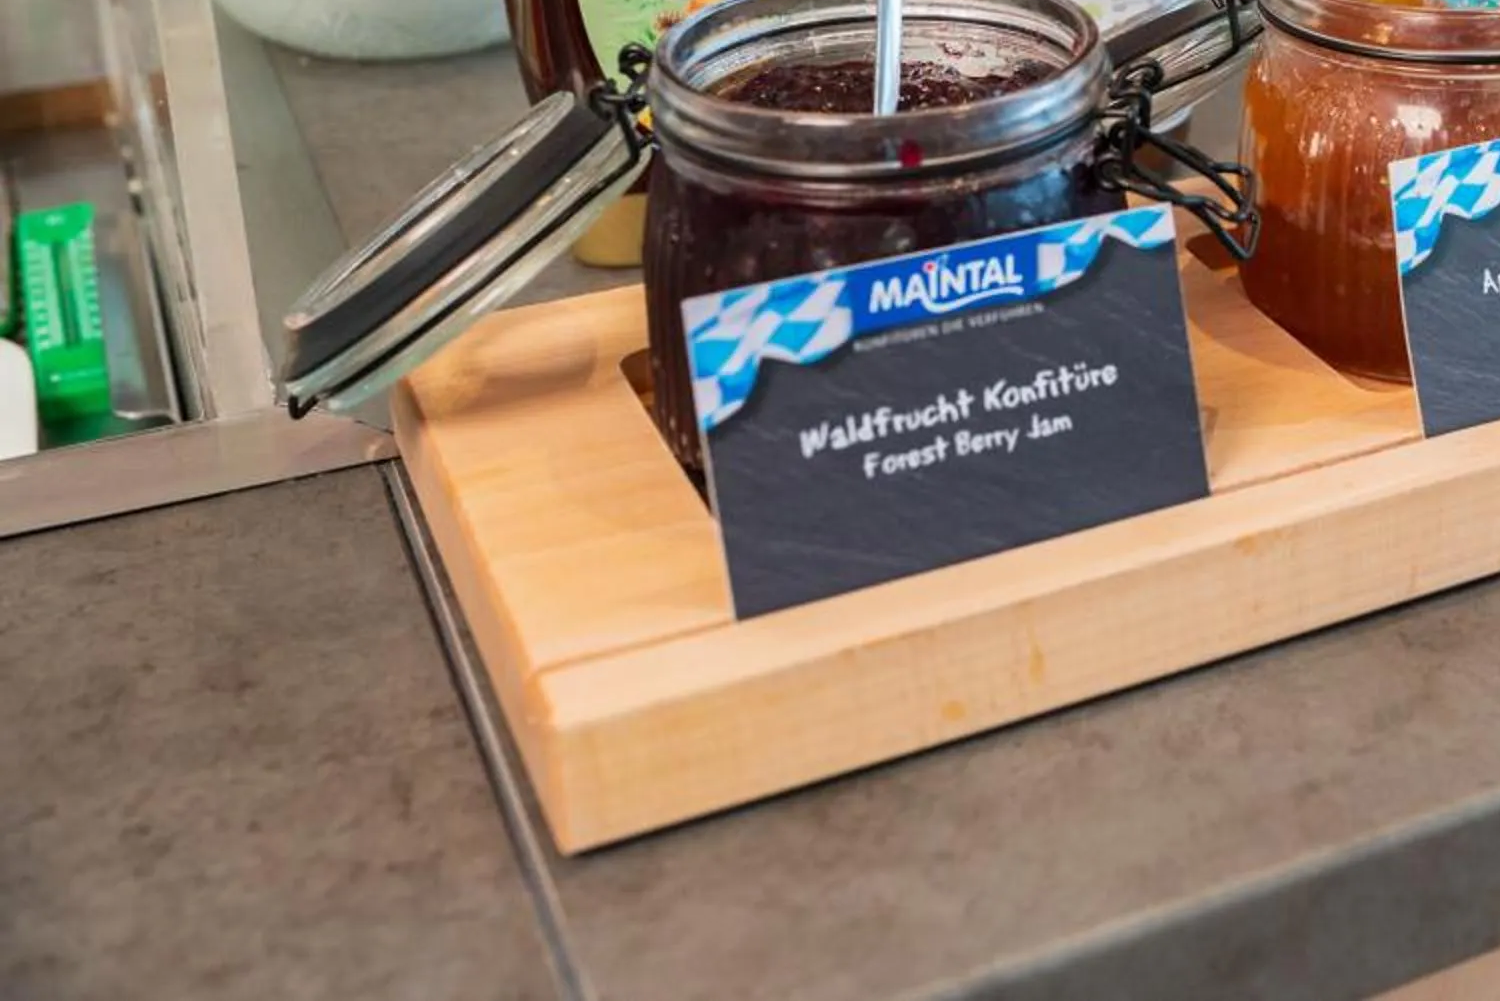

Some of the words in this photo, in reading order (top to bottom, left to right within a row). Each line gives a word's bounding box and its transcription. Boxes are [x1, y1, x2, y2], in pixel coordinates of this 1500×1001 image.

[869, 253, 1024, 315] MAINTAL
[800, 388, 975, 458] Waldfrucht
[984, 361, 1119, 418] Konfitüre
[863, 439, 949, 478] Forest
[955, 425, 1019, 458] Berry
[1027, 414, 1073, 440] Jam
